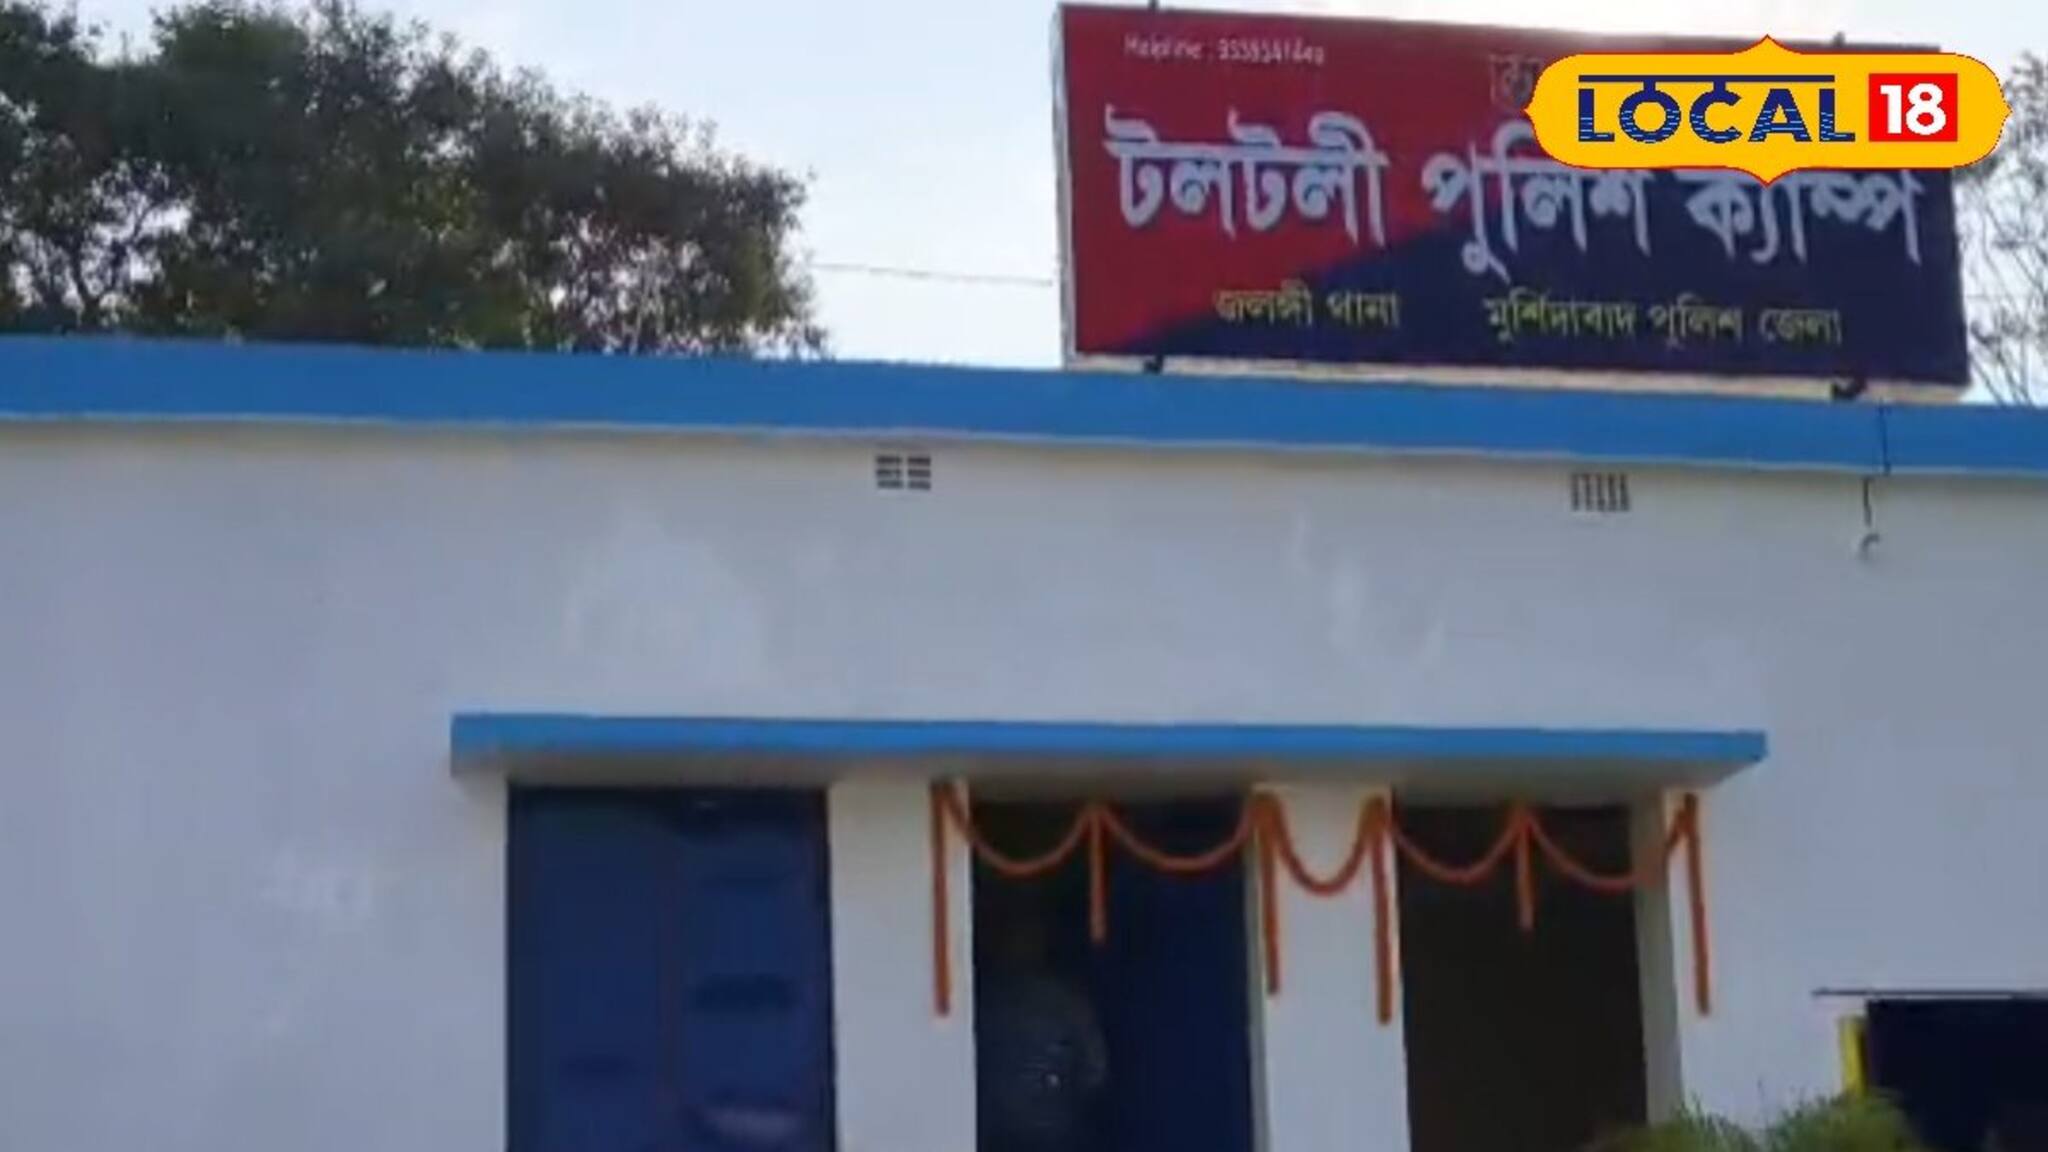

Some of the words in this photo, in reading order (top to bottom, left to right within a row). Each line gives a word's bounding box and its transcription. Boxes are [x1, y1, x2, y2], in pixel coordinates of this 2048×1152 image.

[1103, 103, 1389, 247] টলটলী
[1421, 122, 1655, 285] পুলিশ
[1326, 290, 1399, 327] থানা
[1483, 286, 1637, 344] মুর্শিদাবাদ
[1648, 293, 1743, 350] পুলিশ
[1758, 307, 1843, 346] জেলা
